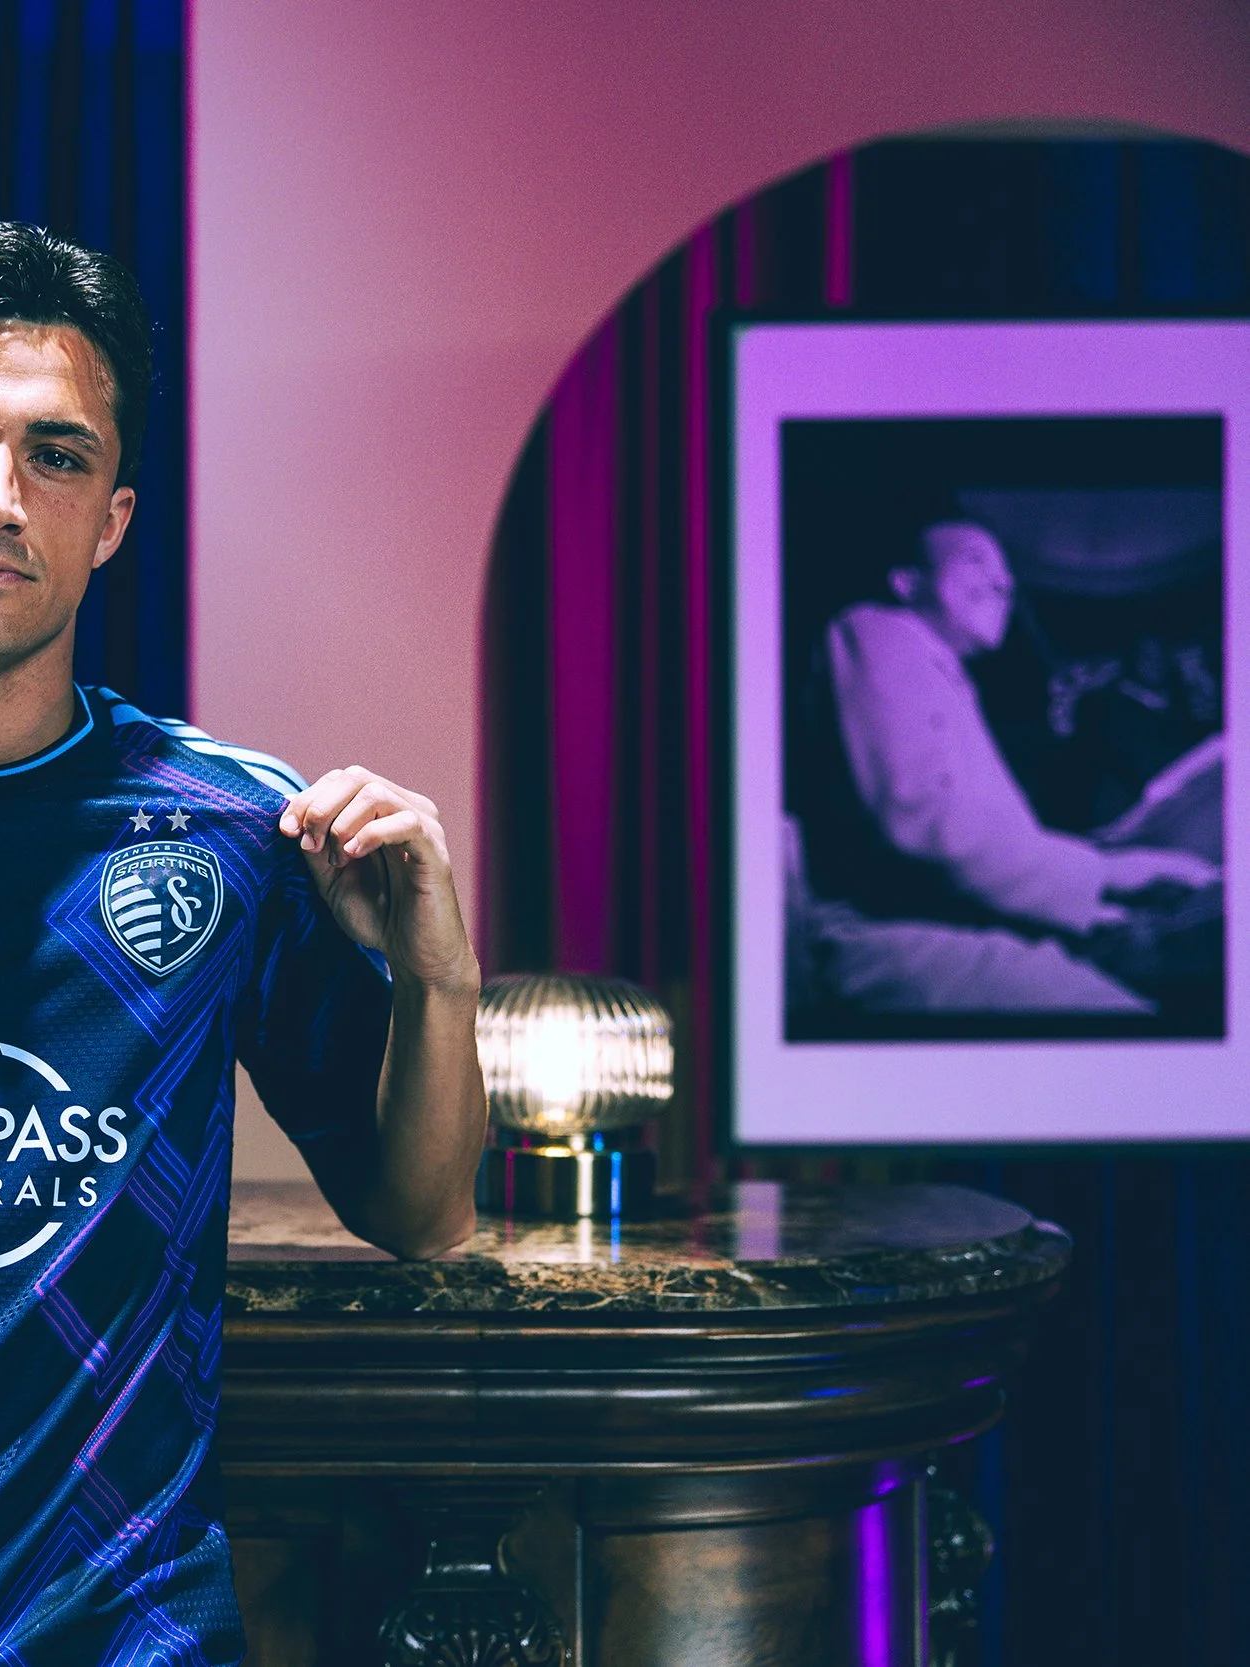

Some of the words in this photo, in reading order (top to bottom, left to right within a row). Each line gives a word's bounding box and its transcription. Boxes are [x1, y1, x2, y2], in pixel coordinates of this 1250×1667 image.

[113, 845, 171, 863] KANSAS
[178, 845, 210, 861] CITY
[114, 858, 209, 880] SPORTING
